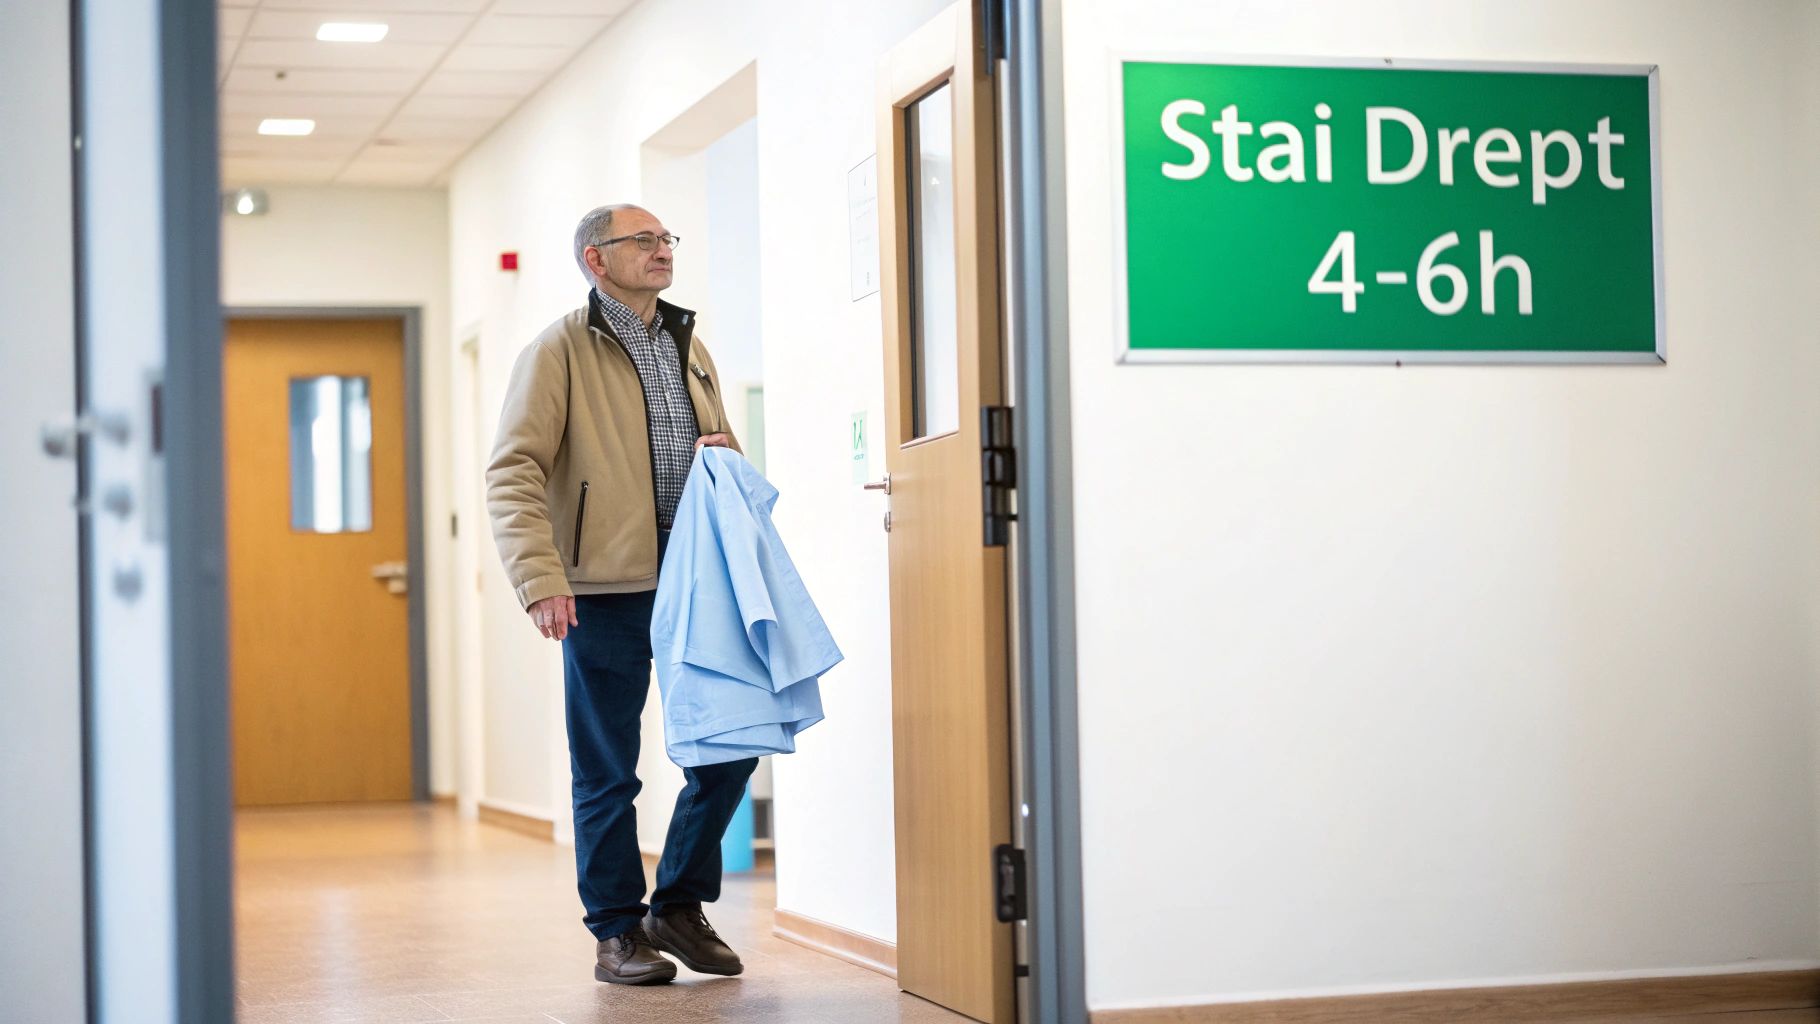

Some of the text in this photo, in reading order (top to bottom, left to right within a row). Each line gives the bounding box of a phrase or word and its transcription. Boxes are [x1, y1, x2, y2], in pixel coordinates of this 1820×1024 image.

[1160, 98, 1625, 205] Stai Drept
[1307, 230, 1533, 316] 4-6h
